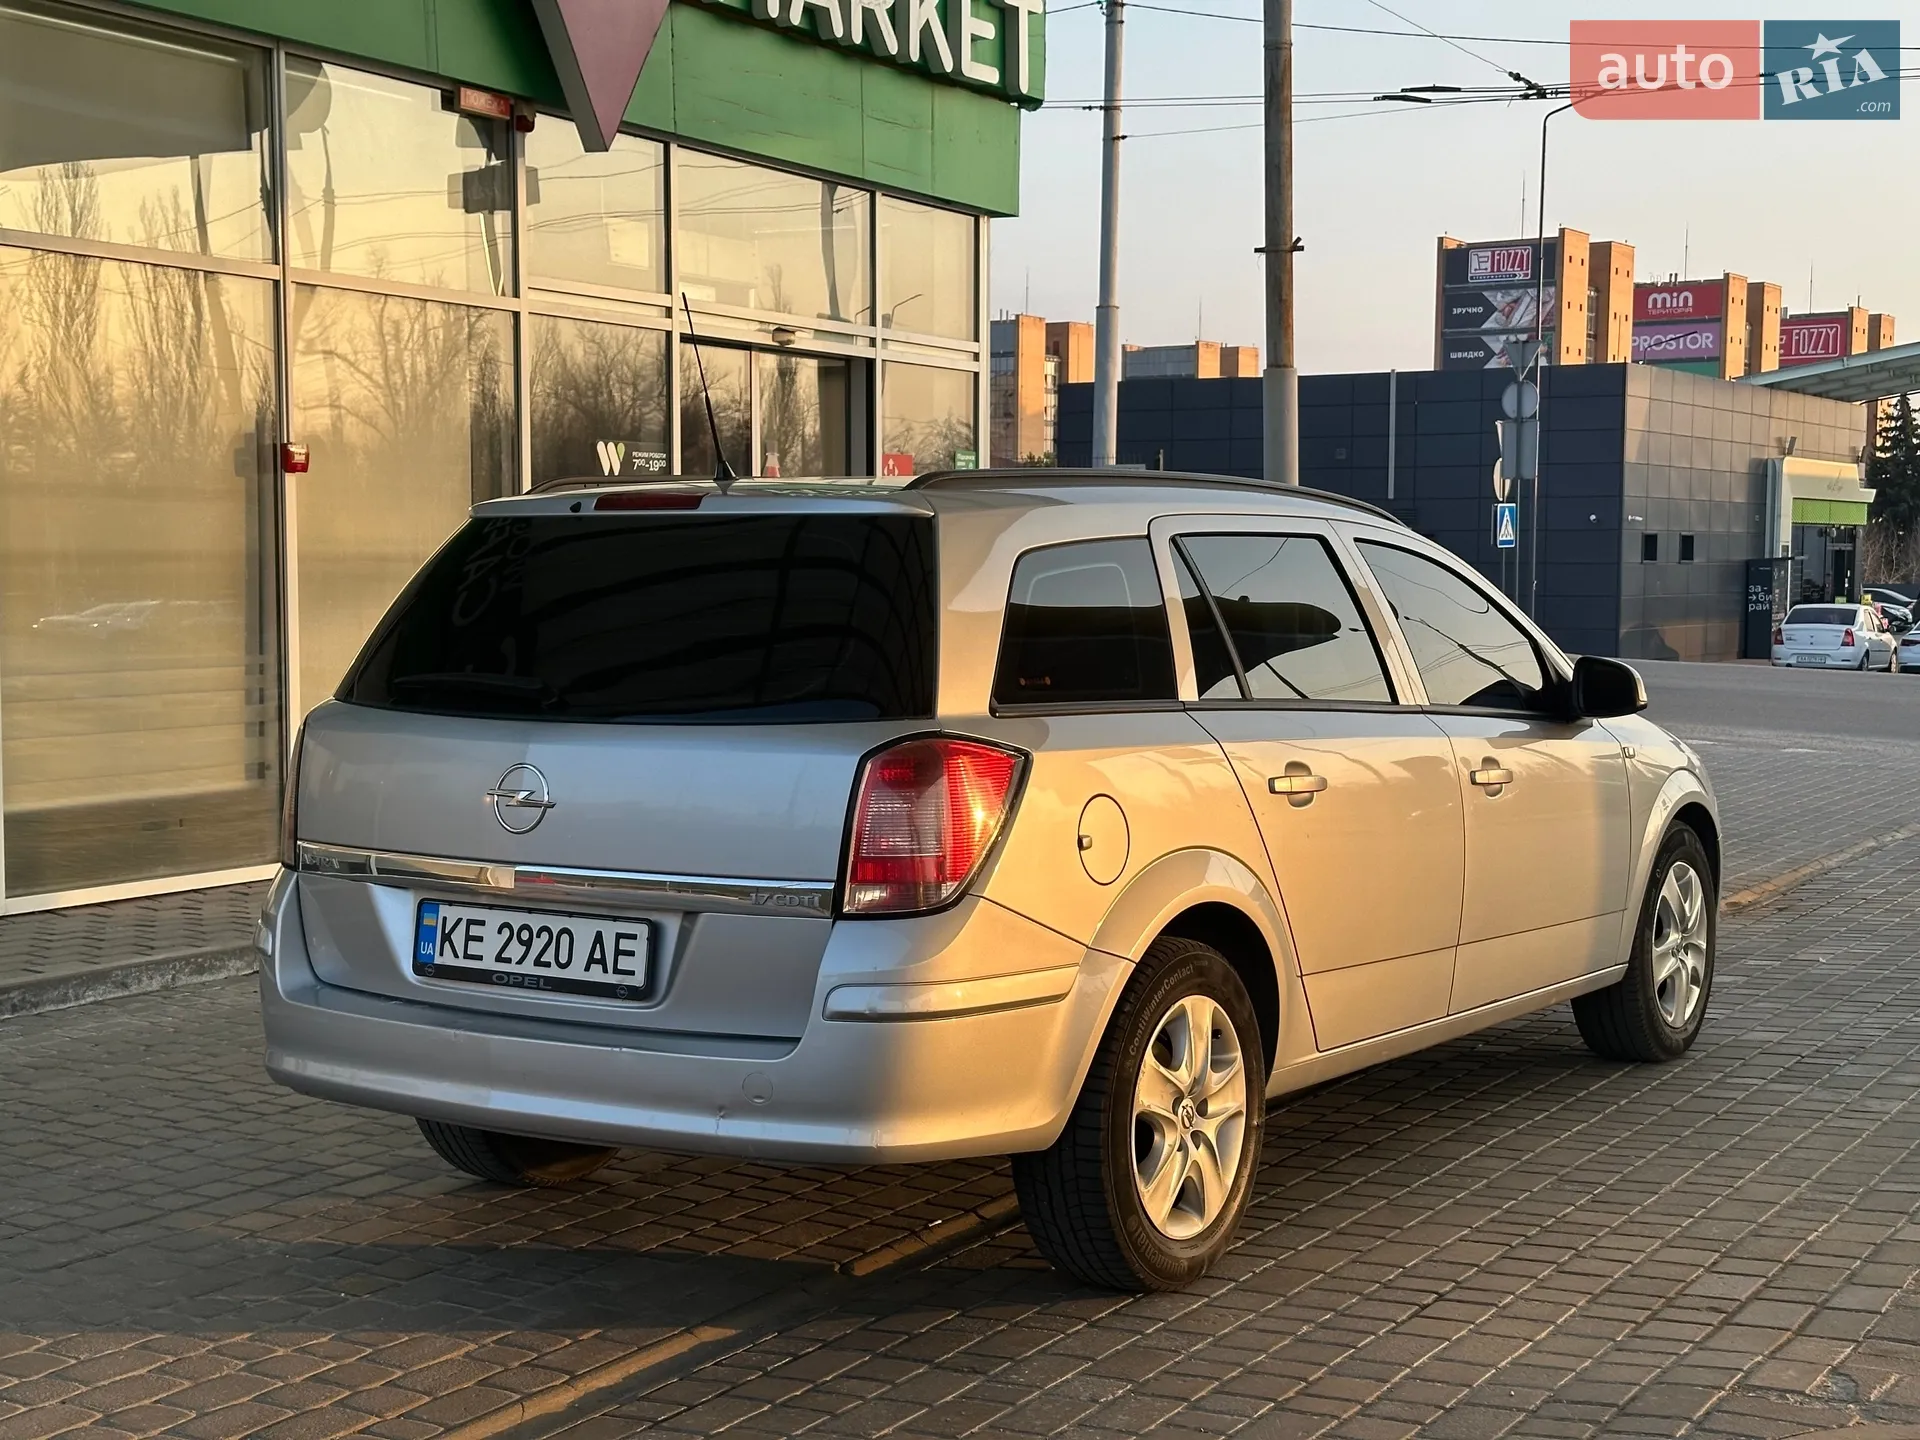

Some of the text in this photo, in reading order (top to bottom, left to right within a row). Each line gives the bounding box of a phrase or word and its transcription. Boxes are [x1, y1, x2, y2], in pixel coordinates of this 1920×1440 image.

[718, 0, 1043, 94] RKET
[1494, 249, 1529, 272] FOZZY
[1647, 291, 1693, 308] min
[1452, 306, 1484, 315] ЗРУЧНО
[1632, 333, 1713, 351] PROSTOR
[1791, 327, 1837, 355] FOZZY
[1450, 350, 1485, 359] ШВИДКО
[1749, 601, 1770, 612] рай
[302, 853, 340, 869] ASTRA
[420, 941, 434, 956] UA
[438, 916, 638, 976] KE 2920 AE
[491, 973, 552, 989] OPEL
[1129, 962, 1194, 1056] ContiWinterContact
